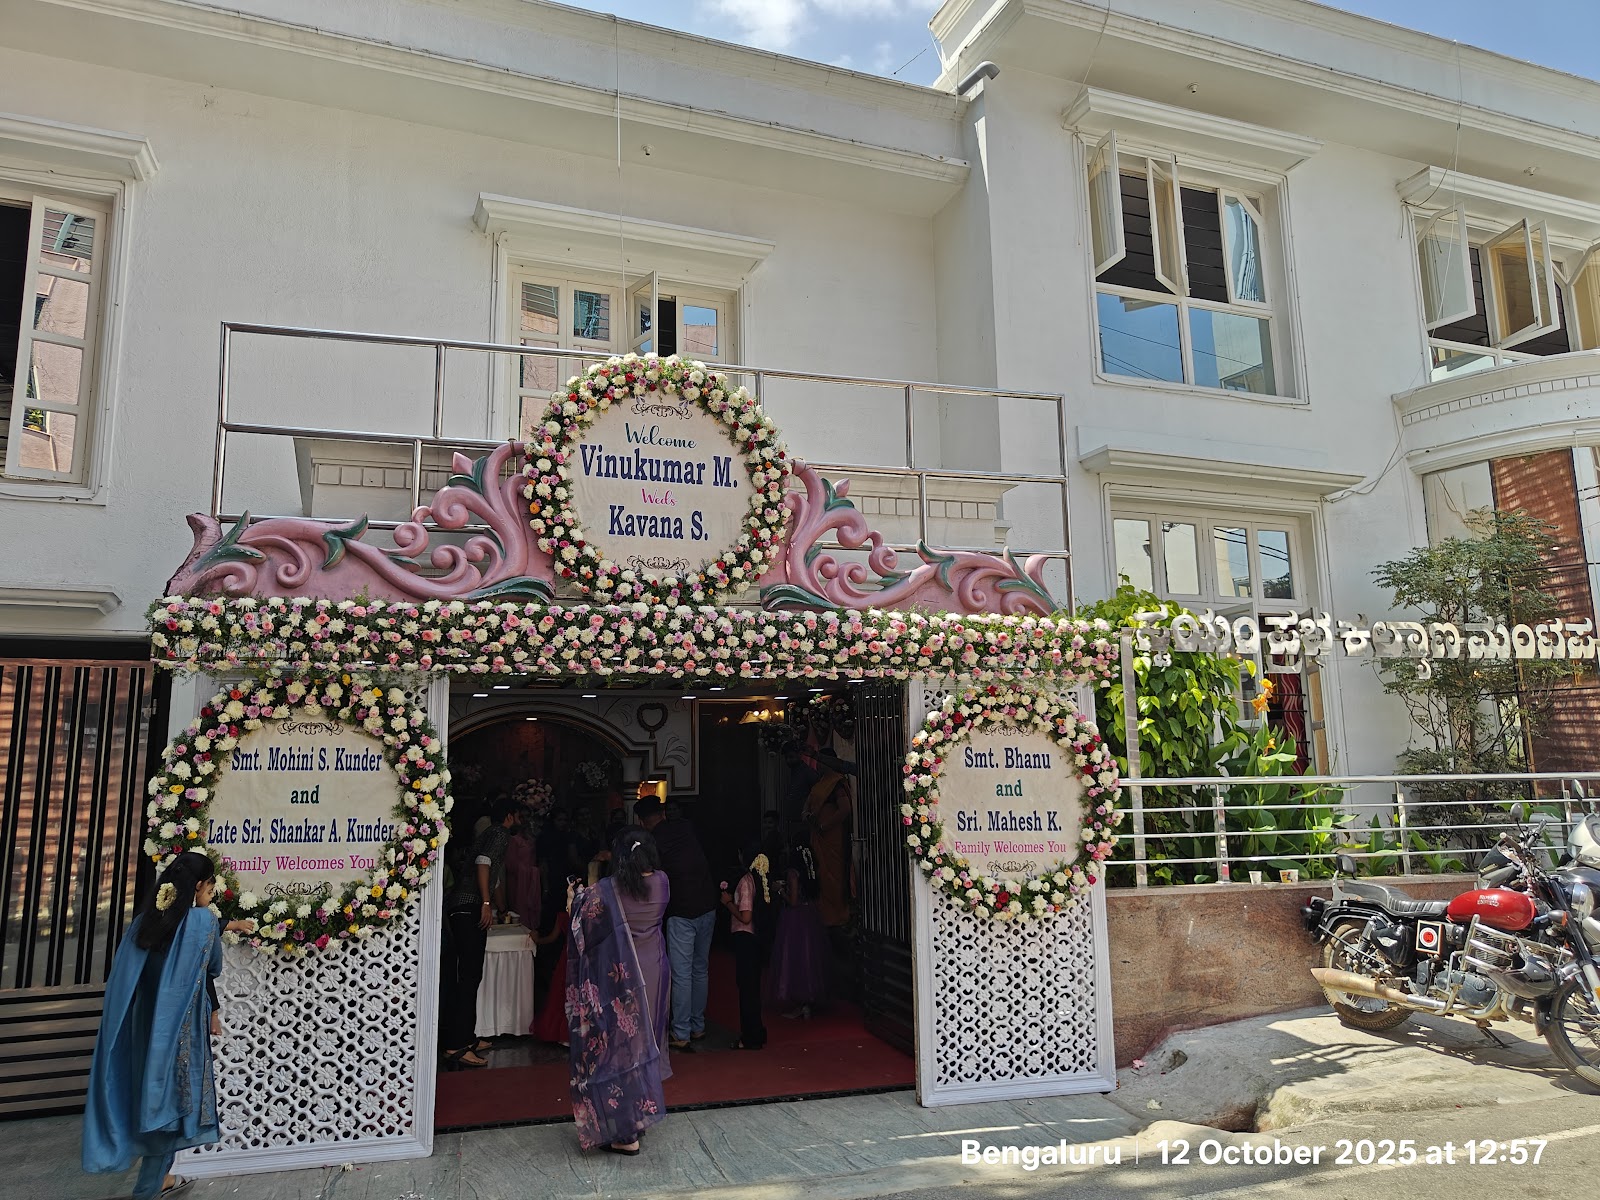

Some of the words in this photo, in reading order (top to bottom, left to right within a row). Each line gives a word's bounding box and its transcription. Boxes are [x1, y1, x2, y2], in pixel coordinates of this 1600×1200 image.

[625, 422, 697, 449] Welcome
[580, 444, 705, 485] Vinukumar
[713, 456, 738, 488] M.
[642, 488, 677, 506] Weds
[609, 505, 683, 540] Kavana
[691, 511, 708, 541] S.
[1464, 615, 1596, 659] ಮಂಟಪ
[231, 747, 262, 771] Smt.
[268, 746, 314, 771] Mohini
[318, 747, 330, 771] S.
[335, 747, 382, 771] Kunder
[964, 747, 999, 768] Smt.
[1004, 747, 1051, 769] Bhanu
[291, 785, 319, 804] and
[996, 779, 1023, 796] and
[208, 819, 237, 845] Late
[242, 818, 264, 843] Sri.
[270, 818, 325, 843] Shankar
[329, 818, 341, 843] A.
[346, 817, 394, 843] Kunder
[957, 810, 982, 831] Sri.
[988, 810, 1042, 831] Mahesh
[1047, 811, 1062, 831] K.
[955, 841, 990, 856] Family
[994, 841, 1044, 853] Welcomes
[1047, 841, 1066, 853] You
[221, 856, 271, 874] Family
[276, 856, 344, 870] Welcomes
[350, 855, 375, 869] You
